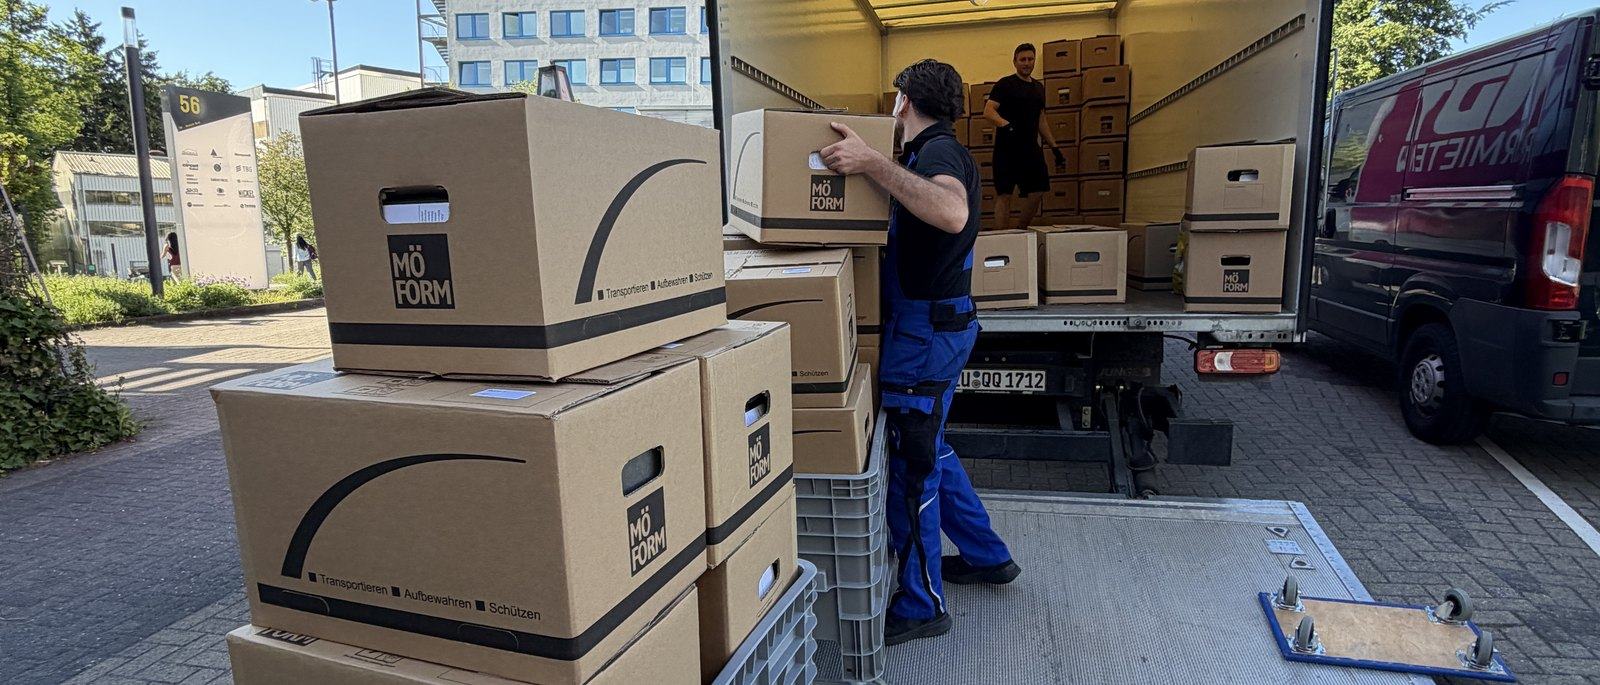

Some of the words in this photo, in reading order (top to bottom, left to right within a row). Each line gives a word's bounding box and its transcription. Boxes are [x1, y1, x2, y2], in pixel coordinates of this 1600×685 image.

[179, 94, 201, 115] 56
[812, 180, 831, 196] MÖ
[811, 196, 843, 210] FORM
[392, 244, 426, 278] MÖ
[606, 283, 649, 299] Transportieren
[657, 276, 689, 289] Aufbewahren
[694, 271, 713, 282] Schützen
[1224, 272, 1239, 283] MÖ
[1224, 282, 1248, 292] FORM
[395, 279, 453, 305] FORM
[799, 369, 829, 377] Schützen
[981, 371, 1002, 388] QQ
[1005, 372, 1044, 389] 1712
[750, 435, 762, 466] MÖ
[750, 453, 770, 485] FORM
[629, 505, 651, 547] MÖ
[631, 526, 666, 572] FORM
[318, 573, 388, 595] Transportieren
[404, 588, 472, 610] Aufbewahren
[489, 602, 541, 621] Schützen
